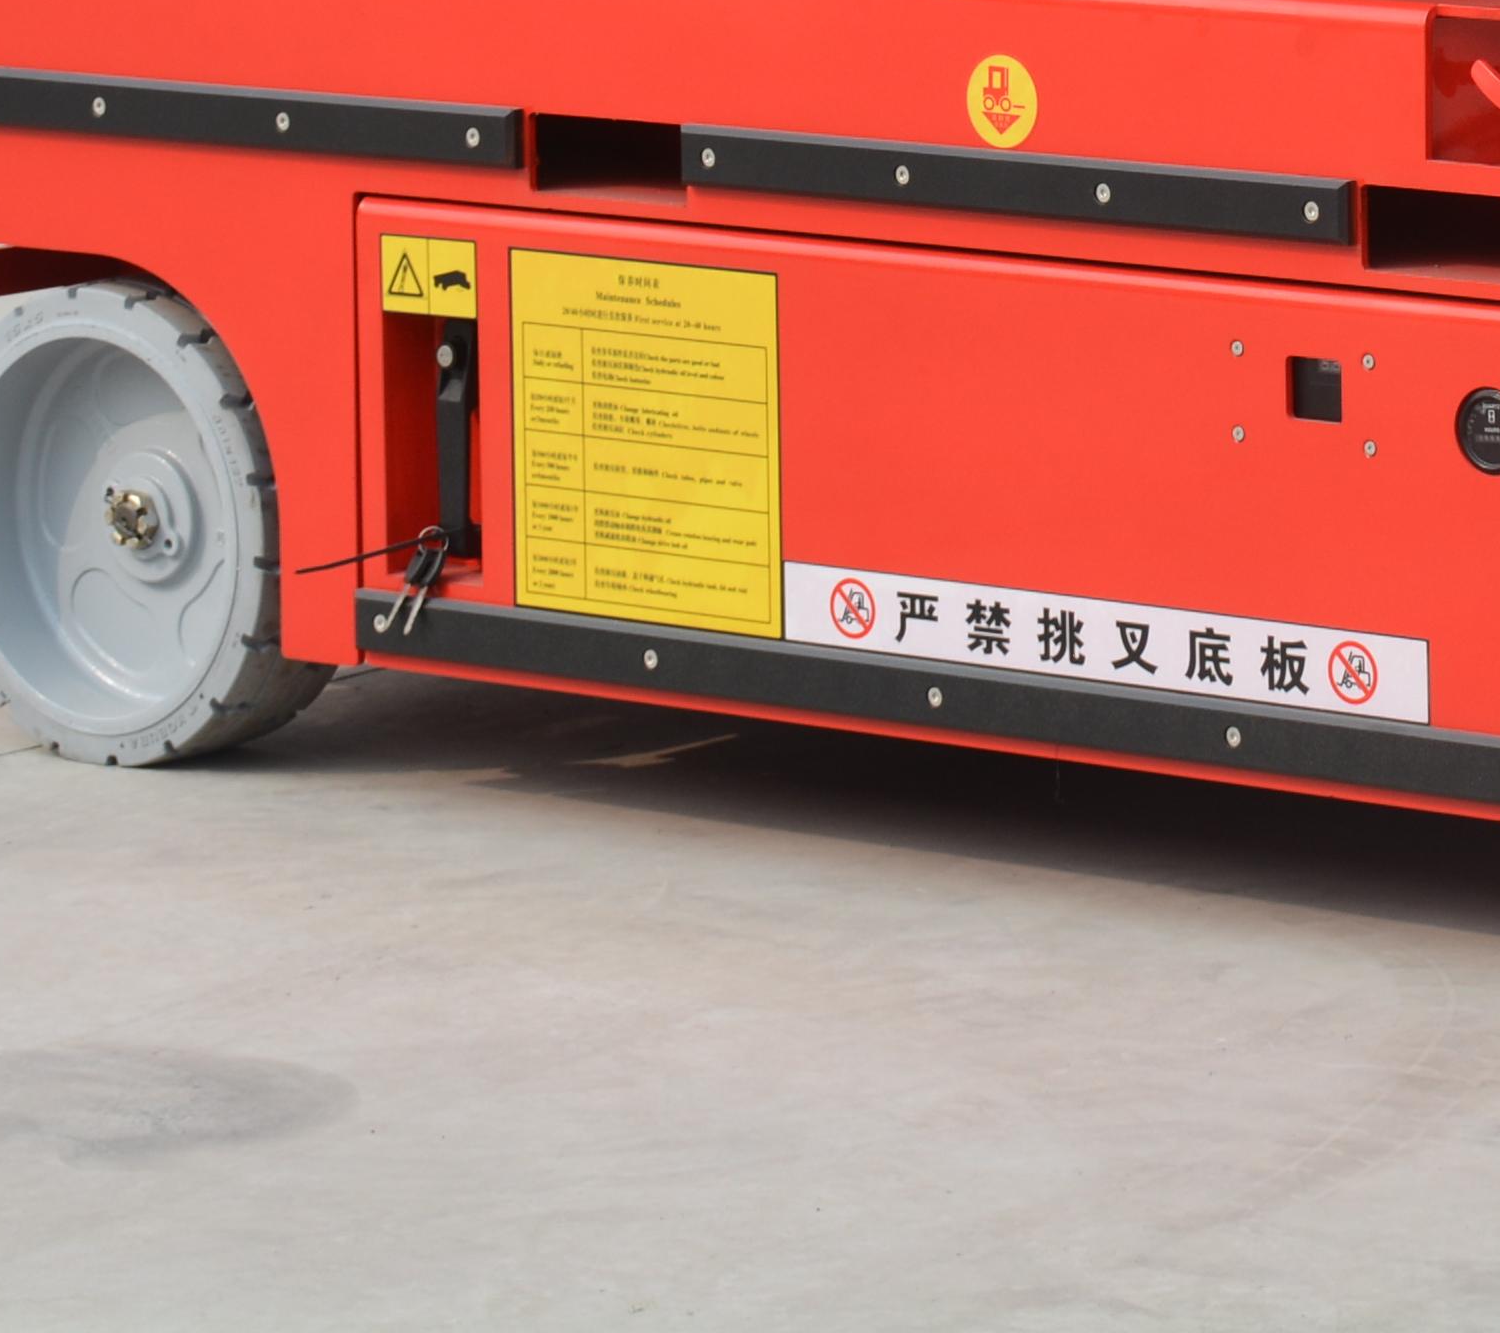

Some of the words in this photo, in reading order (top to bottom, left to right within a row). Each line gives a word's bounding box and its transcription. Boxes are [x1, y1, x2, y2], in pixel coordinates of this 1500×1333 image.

[595, 291, 641, 305] Maintenance
[645, 297, 681, 309] Schedules
[894, 590, 1310, 695] 严禁挑叉底板
